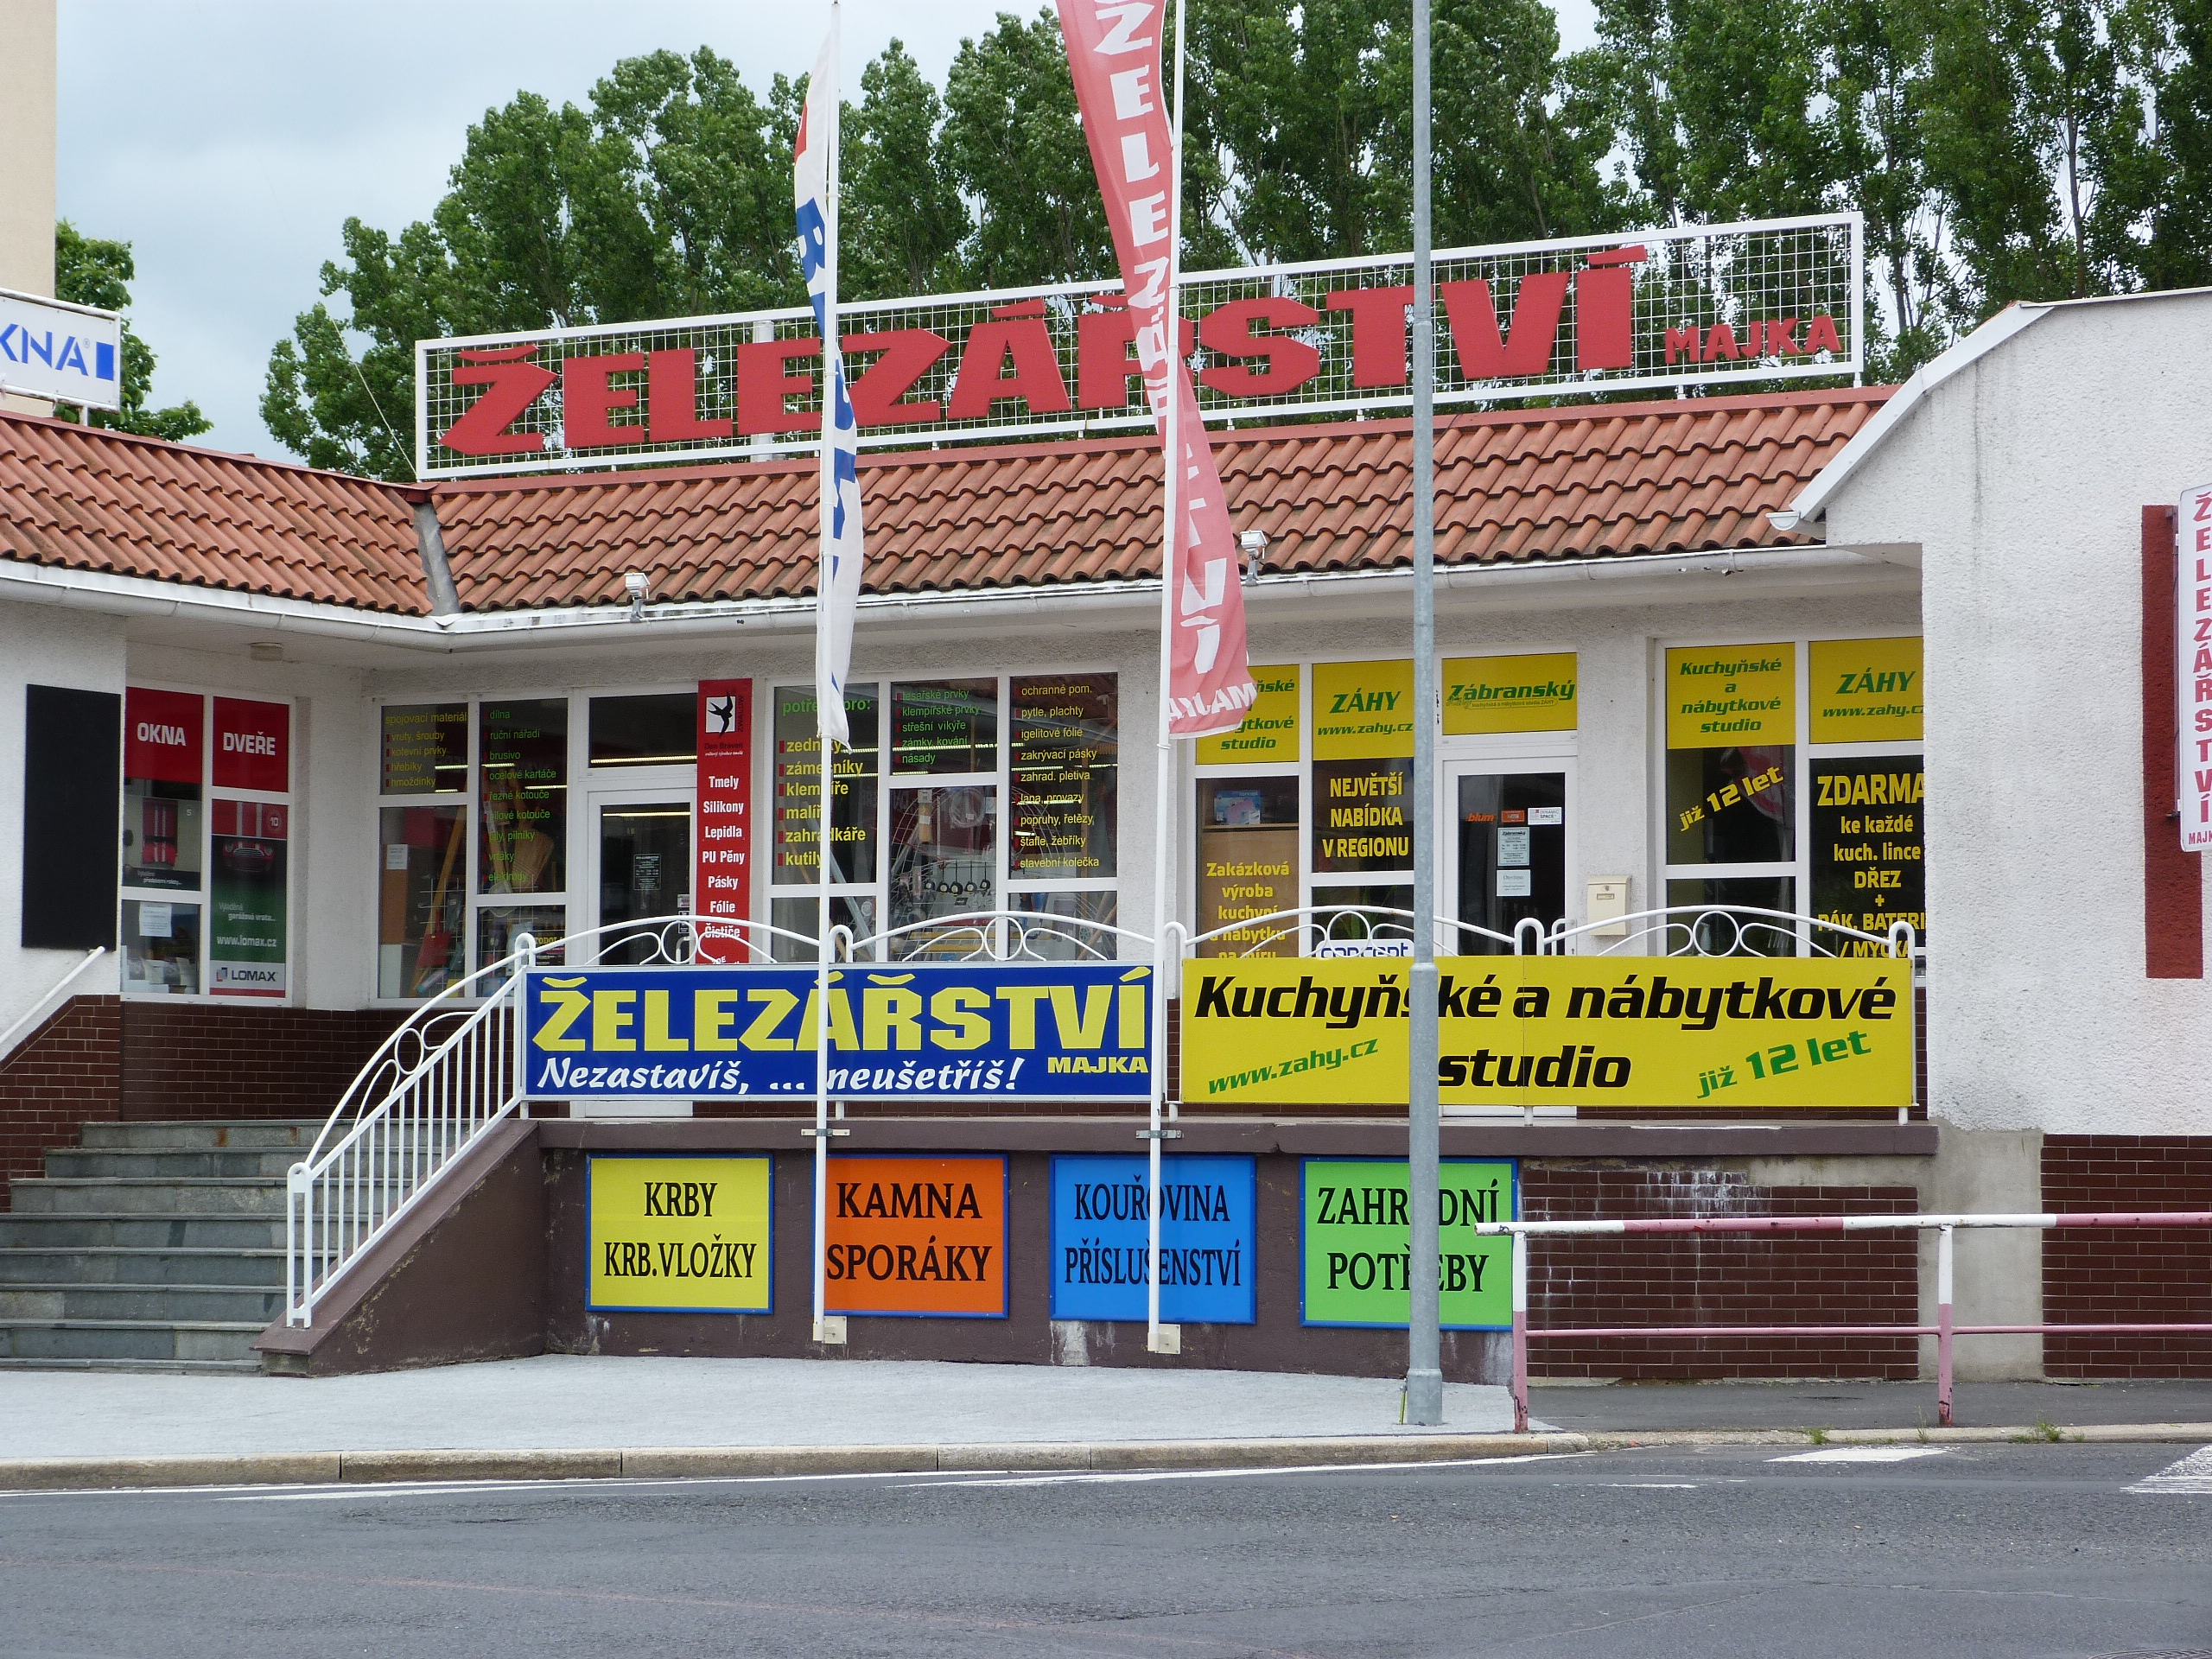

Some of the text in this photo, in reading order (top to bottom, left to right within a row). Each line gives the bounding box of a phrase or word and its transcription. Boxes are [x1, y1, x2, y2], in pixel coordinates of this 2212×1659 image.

[1665, 315, 1842, 365] MAJKA
[1680, 658, 1782, 677] Kuchyňské
[1725, 683, 1737, 693] a
[1835, 667, 1916, 694] ZÁHY
[902, 689, 969, 701] tesařské prvky
[1021, 684, 1092, 696] ochranné pom.
[1447, 680, 1575, 701] Zábranský
[1329, 688, 1402, 714] ZÁHY
[1681, 696, 1782, 715] nábytkové
[385, 712, 467, 725] spojovací materiál
[490, 710, 511, 719] dílna
[902, 705, 952, 717] klempířské
[1021, 706, 1084, 719] pytle, plachty
[902, 720, 966, 732] střešní vikýře
[1235, 715, 1294, 733] ytkové
[1318, 722, 1413, 735] www.zahy.cz
[1700, 718, 1762, 733] studio
[137, 722, 187, 747] OKNA
[416, 731, 445, 741] šrouby
[490, 728, 541, 740] ruční nářadí
[938, 735, 968, 746] kování
[1021, 728, 1083, 741] igelitové fólie
[223, 731, 276, 756] DVEŘE
[786, 738, 841, 754] zedny
[1221, 737, 1276, 750] studio
[423, 746, 448, 757] prvky
[490, 751, 521, 760] brusivo
[902, 753, 936, 764] násady
[1021, 748, 1096, 761] zakrývací pásky
[490, 769, 556, 780] ocelové kartáče
[786, 760, 863, 777] zámeníky
[709, 775, 739, 790] Tmely
[1020, 771, 1090, 782] zahrad. pletiva
[786, 781, 849, 796] klemíře
[1330, 772, 1404, 797] NEJVĚTŠÍ
[1817, 772, 1925, 806] ZDARMA
[489, 790, 550, 801] řezné kotouče
[1046, 792, 1084, 804] provazy
[1679, 766, 1784, 832] již 12 let
[517, 810, 550, 819] kotouče
[703, 801, 744, 815] Silikony
[786, 804, 821, 819] malíř
[1331, 803, 1403, 828] NABÍDKA
[1020, 815, 1061, 827] popruhy,
[1466, 813, 1496, 822] blum
[1840, 814, 1914, 834] ke každé
[705, 826, 742, 841] Lepidla
[1020, 835, 1086, 848] štafle, žebříky
[1322, 836, 1409, 858] V REGIONU
[702, 850, 745, 865] PU Pěny
[1834, 842, 1921, 861] kuch. lince
[1020, 856, 1099, 868] stavební kolečka
[1206, 861, 1290, 877] Zakázková
[708, 875, 739, 890] Pásky
[1854, 867, 1902, 888] DŘEZ
[1222, 883, 1274, 900] výroba
[710, 900, 735, 913] Fólie
[1874, 894, 1885, 906] +
[704, 922, 741, 938] Čističe
[217, 935, 277, 947] www.lomax.cz
[232, 970, 276, 982] LOMAX
[532, 966, 1151, 1051] ŽELEZÁŘSTVÍ
[1513, 985, 1548, 1018] a
[1567, 976, 1896, 1031] nábytkové
[1047, 1057, 1148, 1073] MAJKA
[1209, 1039, 1378, 1095] www.zahy.cz
[1438, 1044, 1631, 1089] studio
[1697, 1028, 1872, 1099] již 12 let
[537, 1057, 749, 1095] Nezastavíš,
[827, 1058, 1026, 1091] neušetříš!
[644, 1182, 718, 1217] KRBY
[836, 1183, 982, 1219] KAMNA
[1074, 1174, 1230, 1222] KOUŘOVINA
[1317, 1179, 1499, 1226] ZAHRDNÍ
[604, 1234, 757, 1278] KRB.VLOŽKY
[827, 1236, 992, 1281] SPORÁKY
